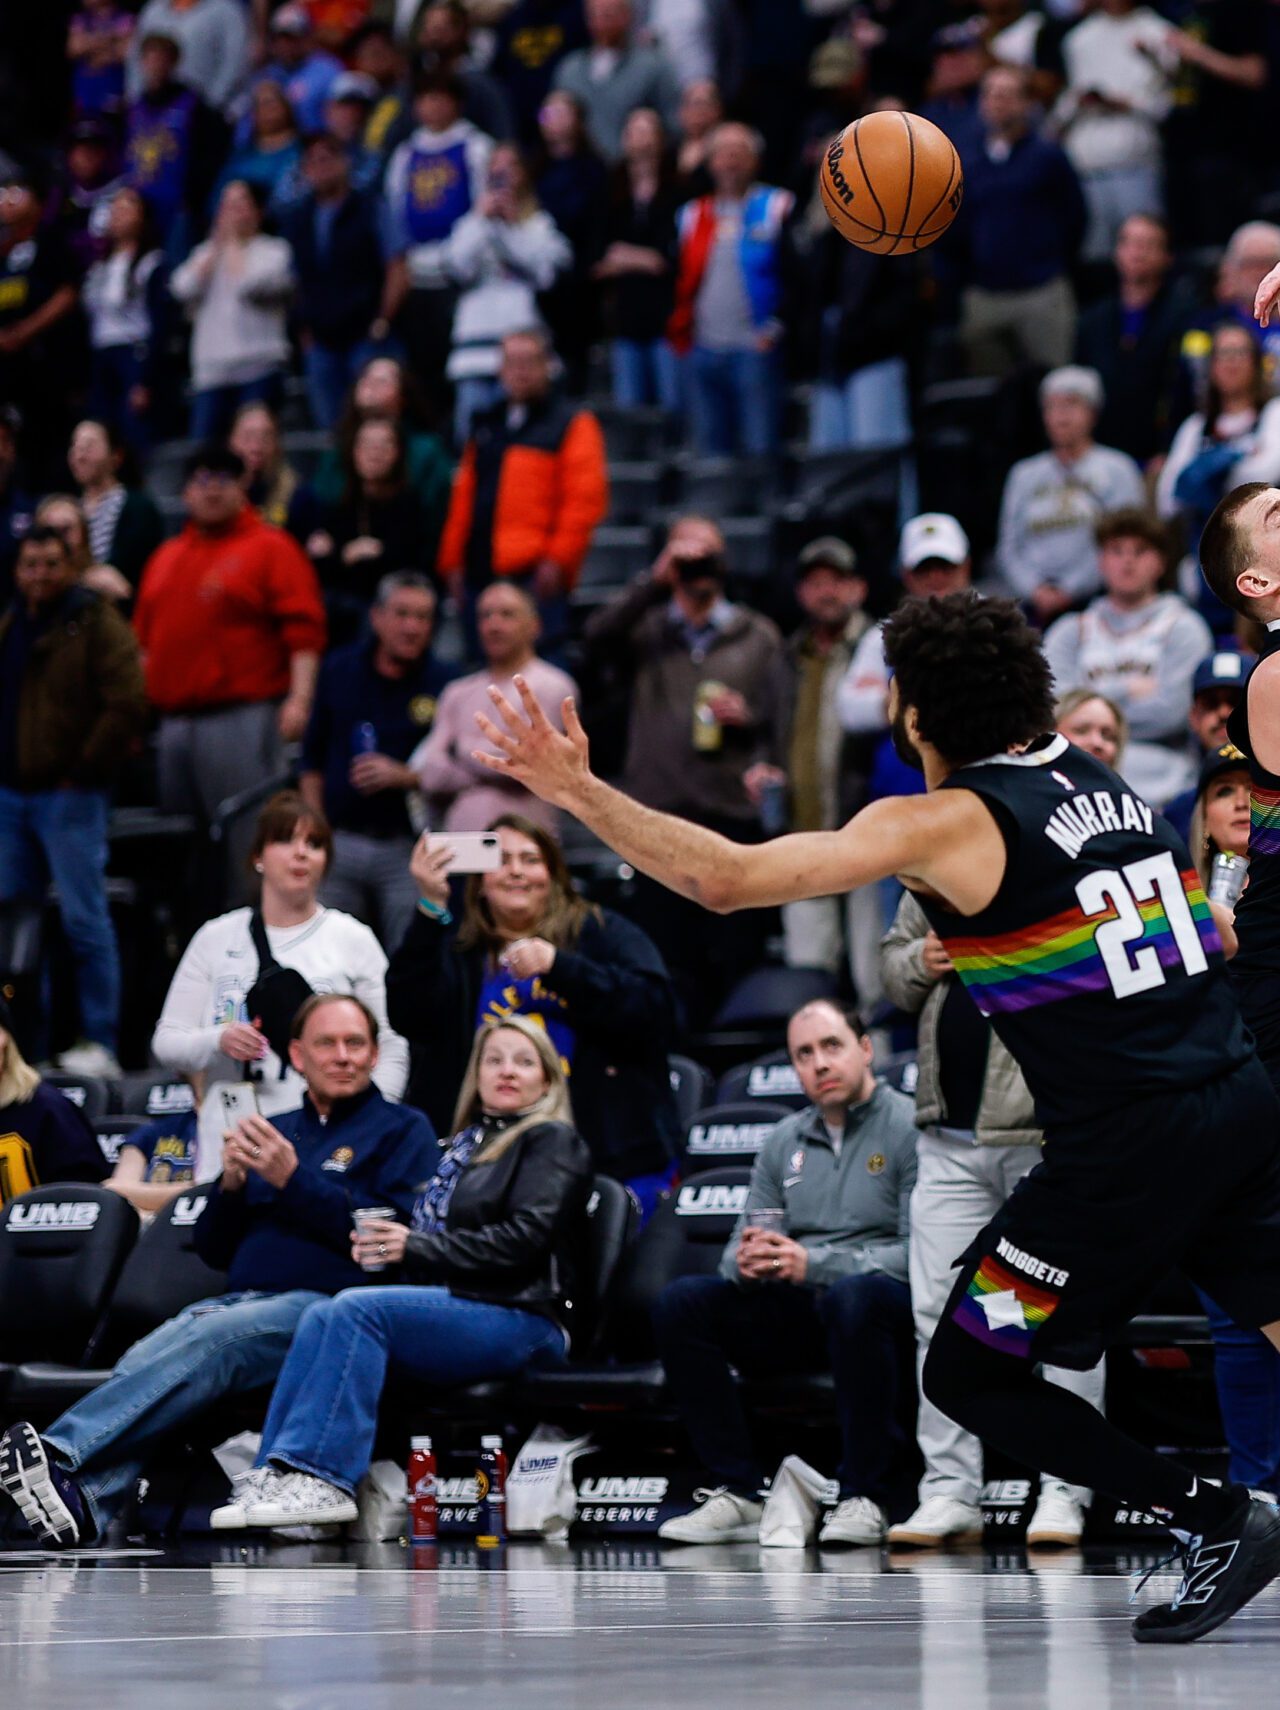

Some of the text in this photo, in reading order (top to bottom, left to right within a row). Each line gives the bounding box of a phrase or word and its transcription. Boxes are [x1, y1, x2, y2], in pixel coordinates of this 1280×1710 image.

[828, 130, 854, 206] ilson
[1045, 791, 1153, 860] MURRAY
[1074, 851, 1208, 999] 27
[8, 1202, 100, 1225] UMB
[678, 1185, 750, 1209] UM
[996, 1236, 1070, 1287] NUGGETS
[579, 1477, 669, 1497] UMB
[577, 1507, 658, 1522] ESERVE
